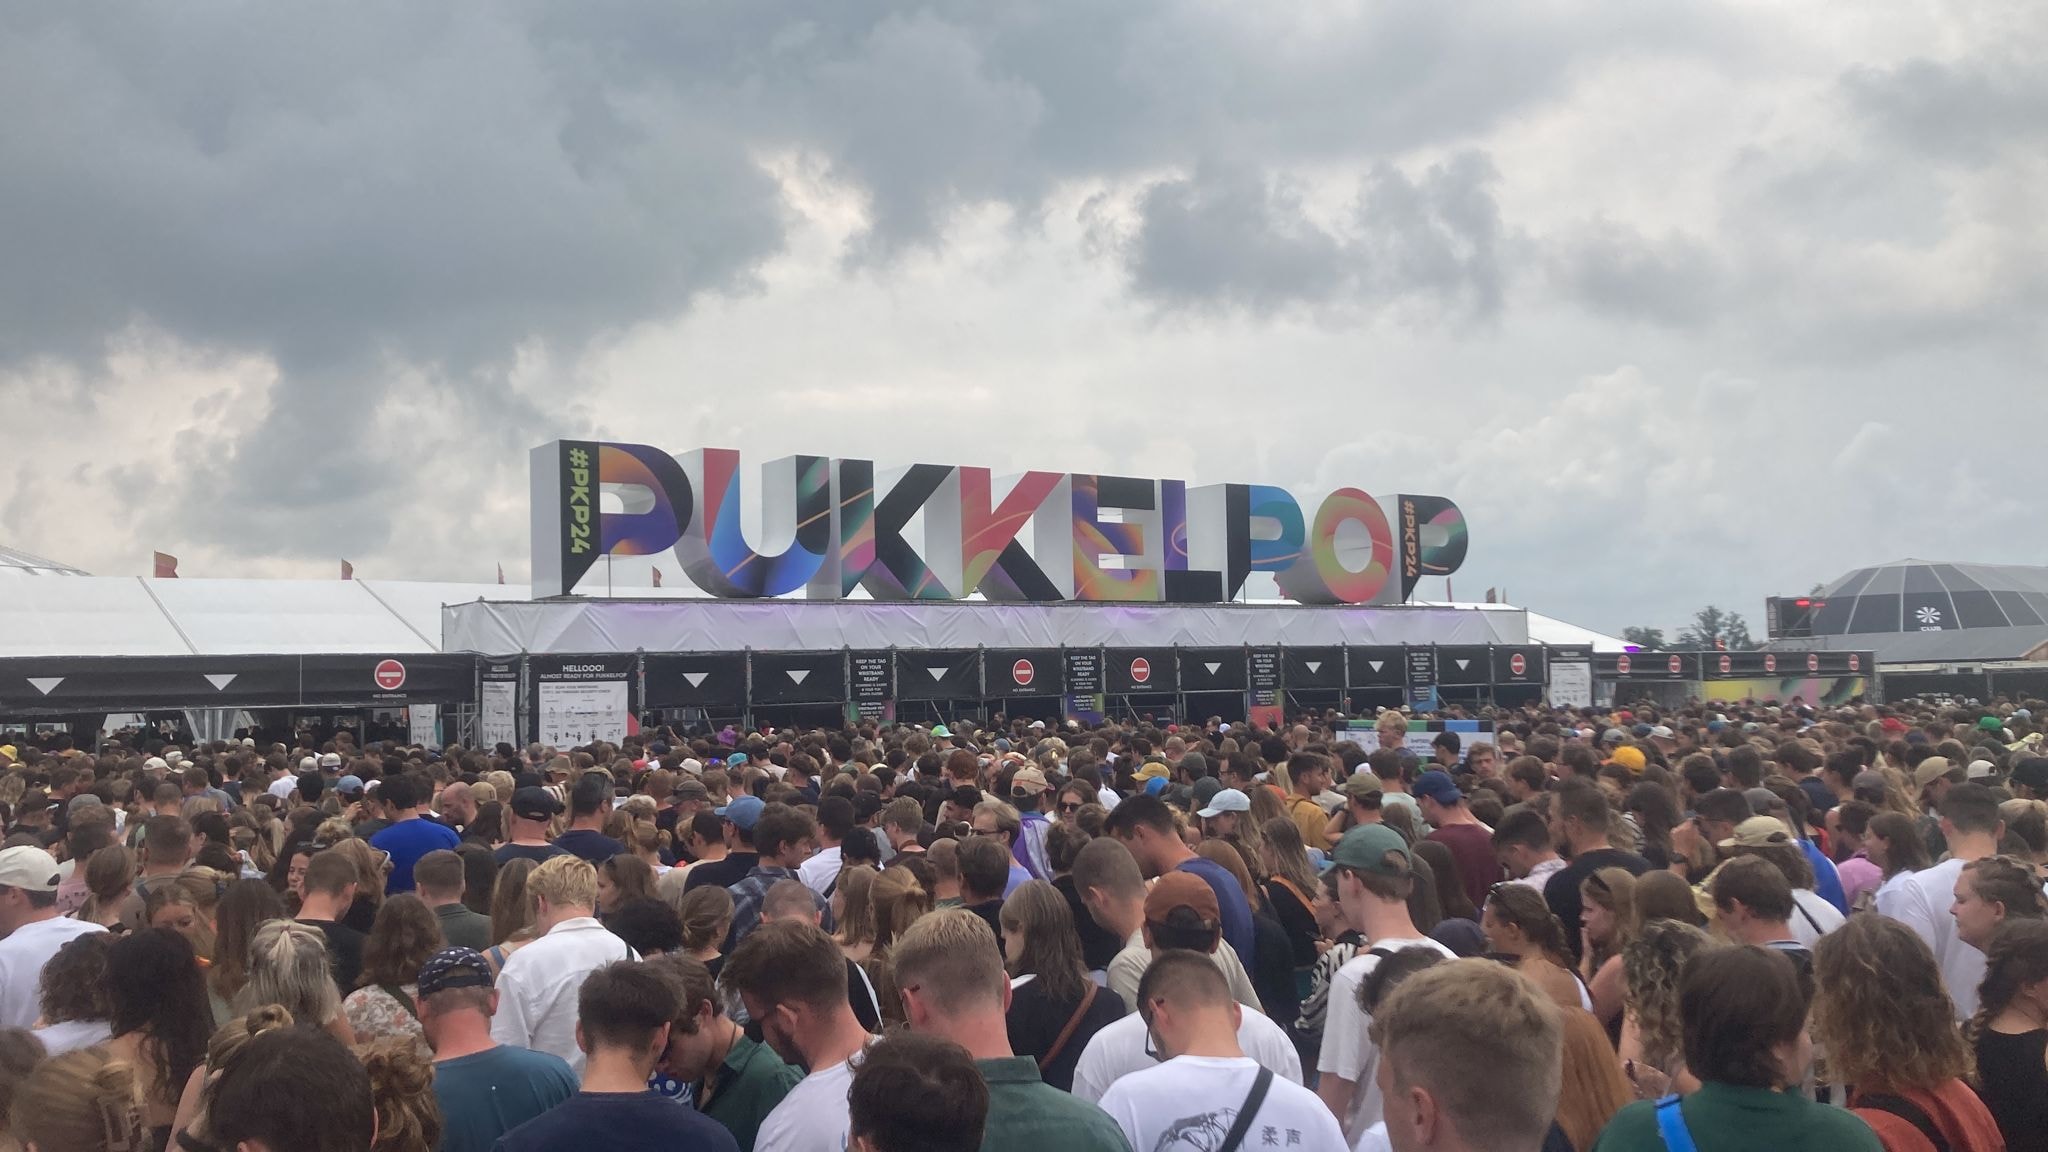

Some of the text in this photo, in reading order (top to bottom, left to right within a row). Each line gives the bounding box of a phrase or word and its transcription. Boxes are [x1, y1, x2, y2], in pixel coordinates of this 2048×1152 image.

[531, 440, 1468, 604] PUKKELPOP
[569, 448, 591, 554] #PKP24
[1404, 500, 1417, 577] #PKP24
[562, 664, 605, 672] HELLOOO!
